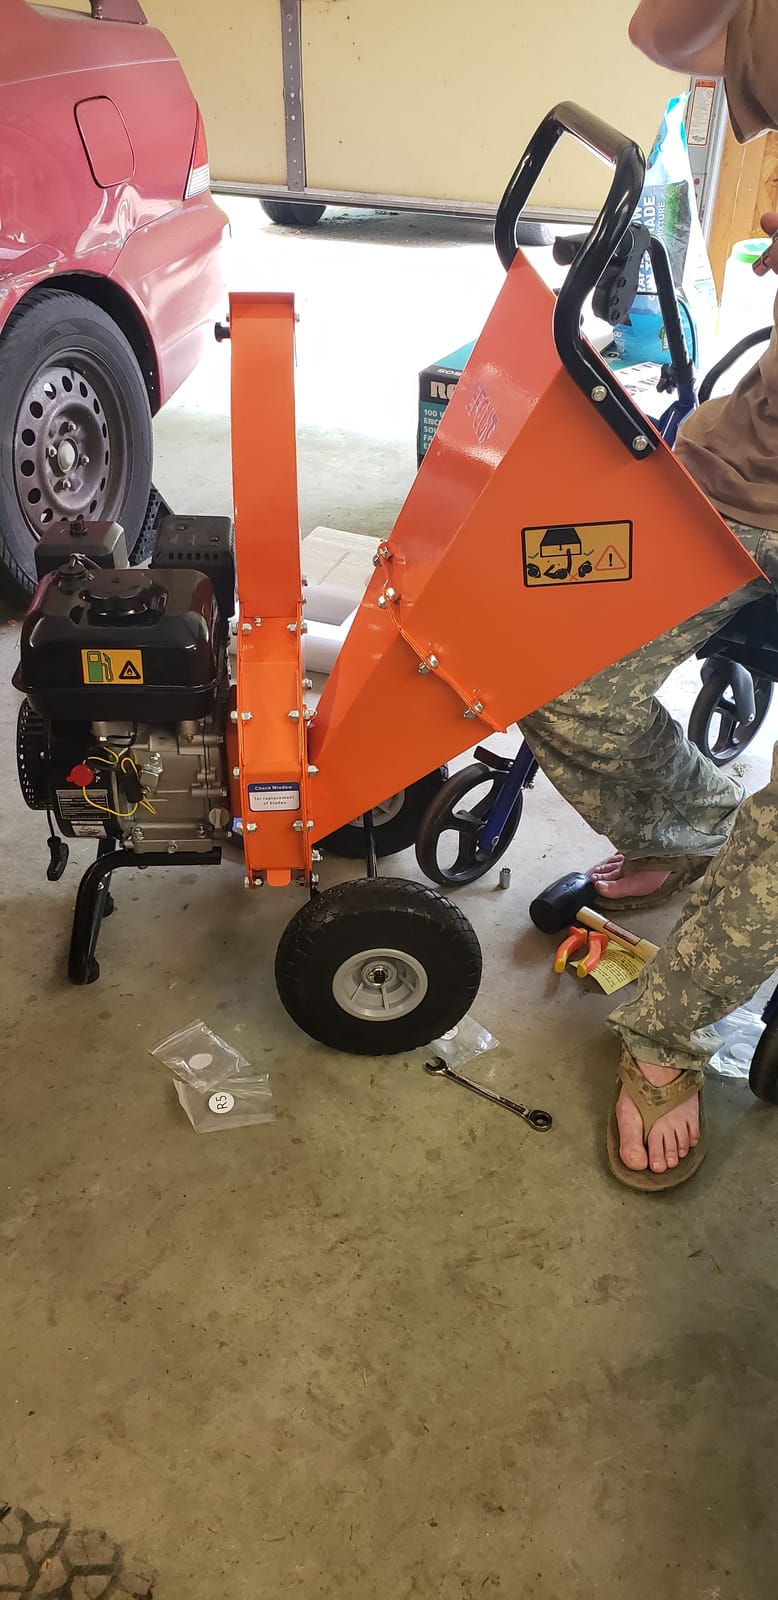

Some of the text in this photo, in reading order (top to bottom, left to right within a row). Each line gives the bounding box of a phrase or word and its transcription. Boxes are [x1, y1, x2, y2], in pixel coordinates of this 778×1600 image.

[423, 409, 438, 417] 100
[423, 417, 439, 426] ENC
[215, 1095, 228, 1110] R5
